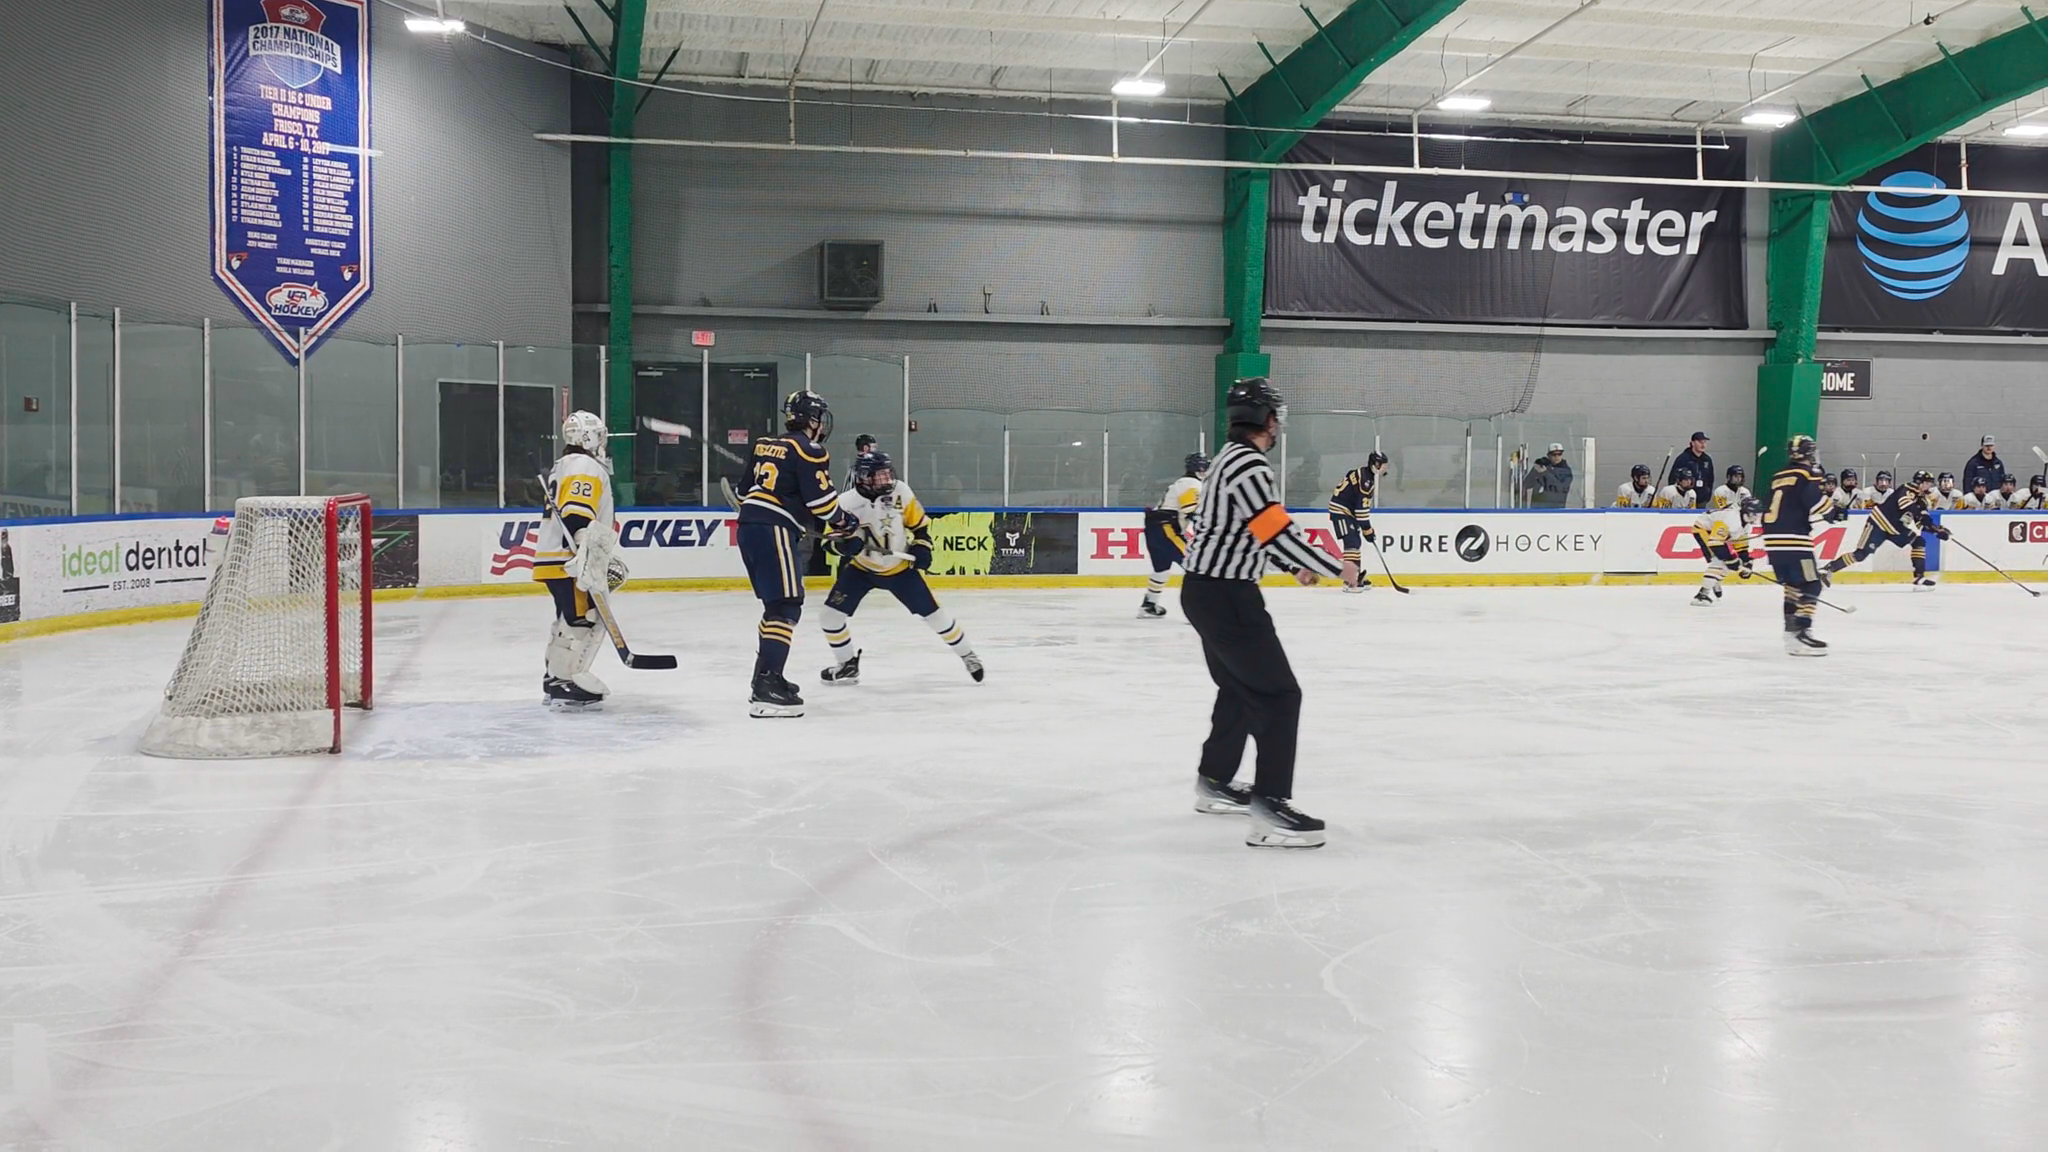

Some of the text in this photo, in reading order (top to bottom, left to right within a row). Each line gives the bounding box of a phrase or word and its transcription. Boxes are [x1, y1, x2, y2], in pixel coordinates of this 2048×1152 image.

[253, 25, 336, 56] 2017 NATIONAL
[252, 41, 338, 68] CHAMPIONSHIPS
[260, 85, 278, 100] TIER
[305, 93, 332, 111] UNDER
[272, 103, 320, 123] CHAMPIONS
[274, 118, 319, 138] FRISCO, TX
[262, 132, 288, 149] APRIL
[288, 136, 295, 150] 6
[1297, 179, 1718, 256] ticketmaster
[1991, 202, 2048, 277] A
[273, 303, 319, 317] HOCKEY
[571, 481, 592, 497] 32
[943, 536, 988, 551] NECK
[1001, 548, 1025, 556] TITAN
[1382, 534, 1603, 553] PURE HOCKEY
[61, 537, 207, 578] ideal dental
[113, 578, 150, 591] EST. 2008
